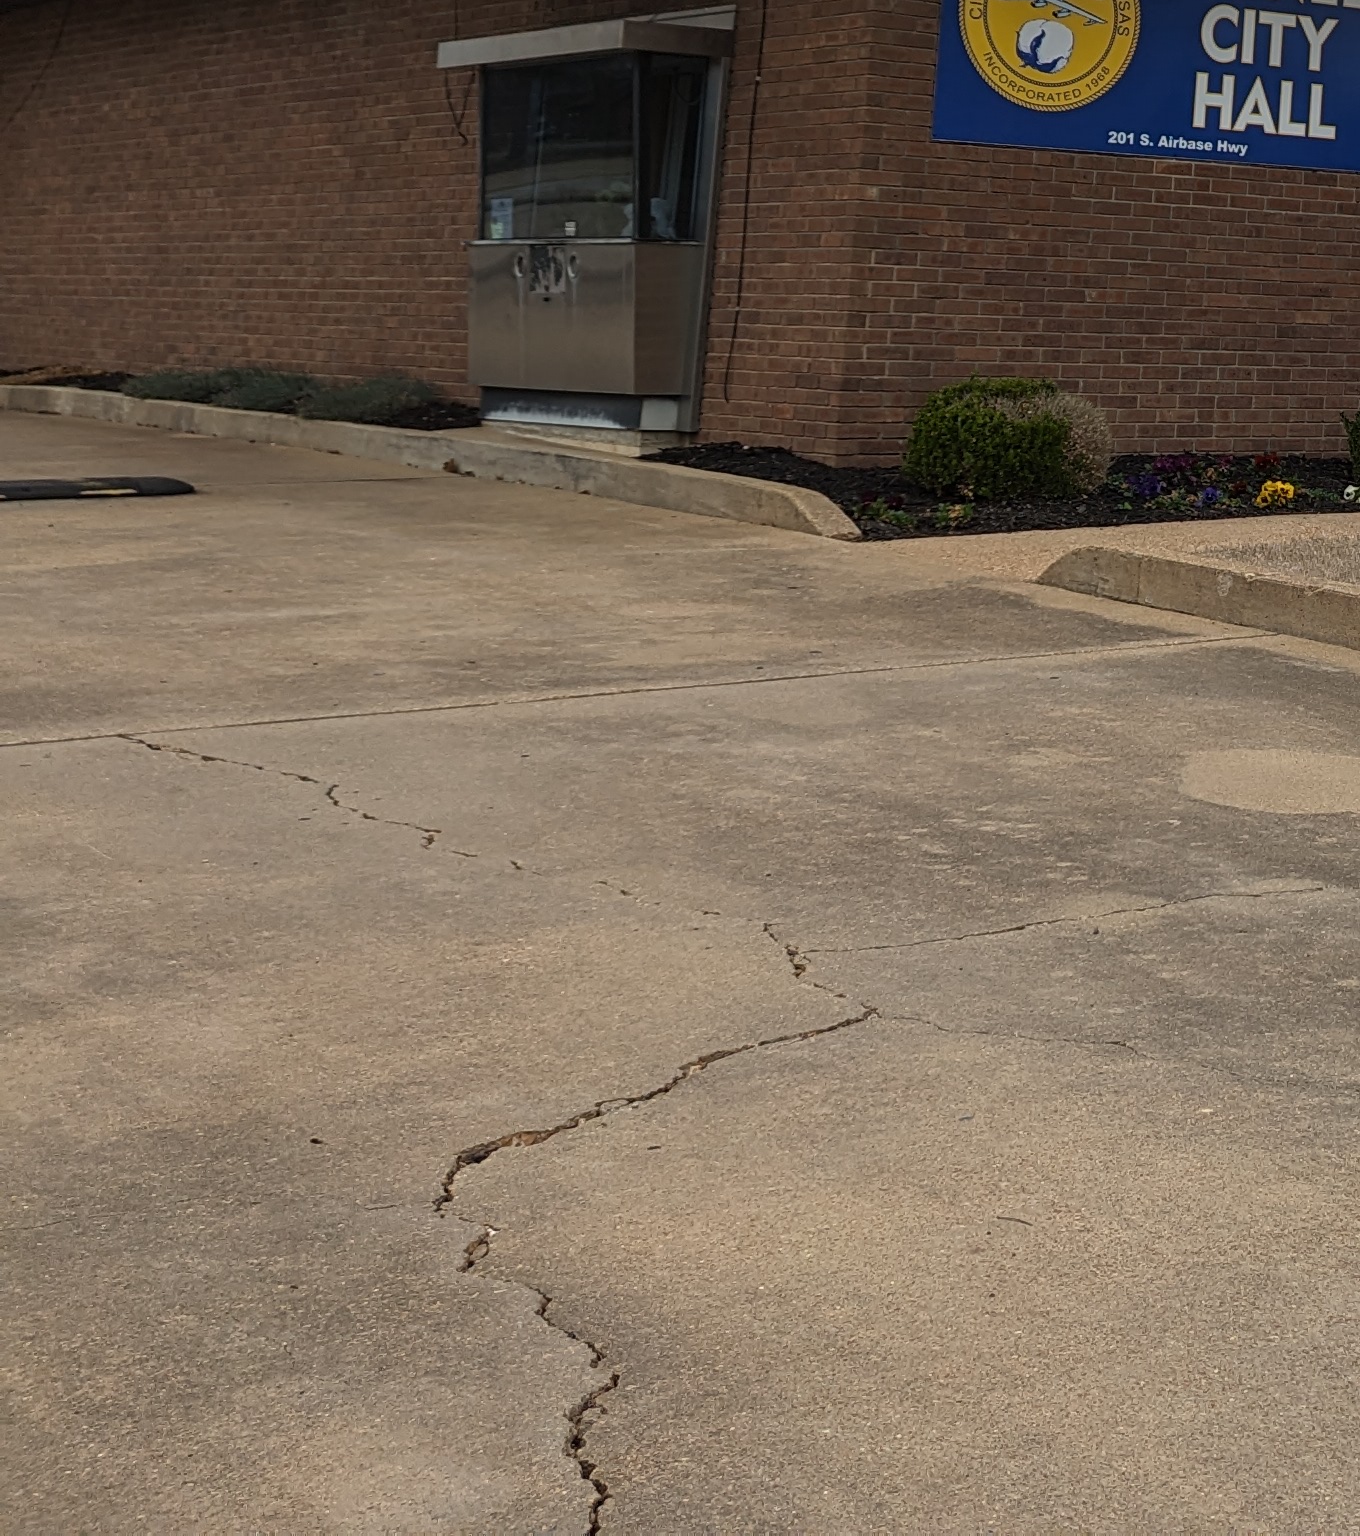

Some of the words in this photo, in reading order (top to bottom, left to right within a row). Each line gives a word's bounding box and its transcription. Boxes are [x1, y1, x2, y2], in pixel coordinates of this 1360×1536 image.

[1200, 3, 1339, 72] CITY
[983, 51, 1082, 102] INCORPORATED
[1085, 66, 1111, 92] 1968
[1192, 71, 1337, 140] HALL
[1107, 130, 1135, 145] 201
[1139, 133, 1154, 147] S.
[1157, 135, 1213, 151] Airbase
[1216, 139, 1249, 157] Hwy
